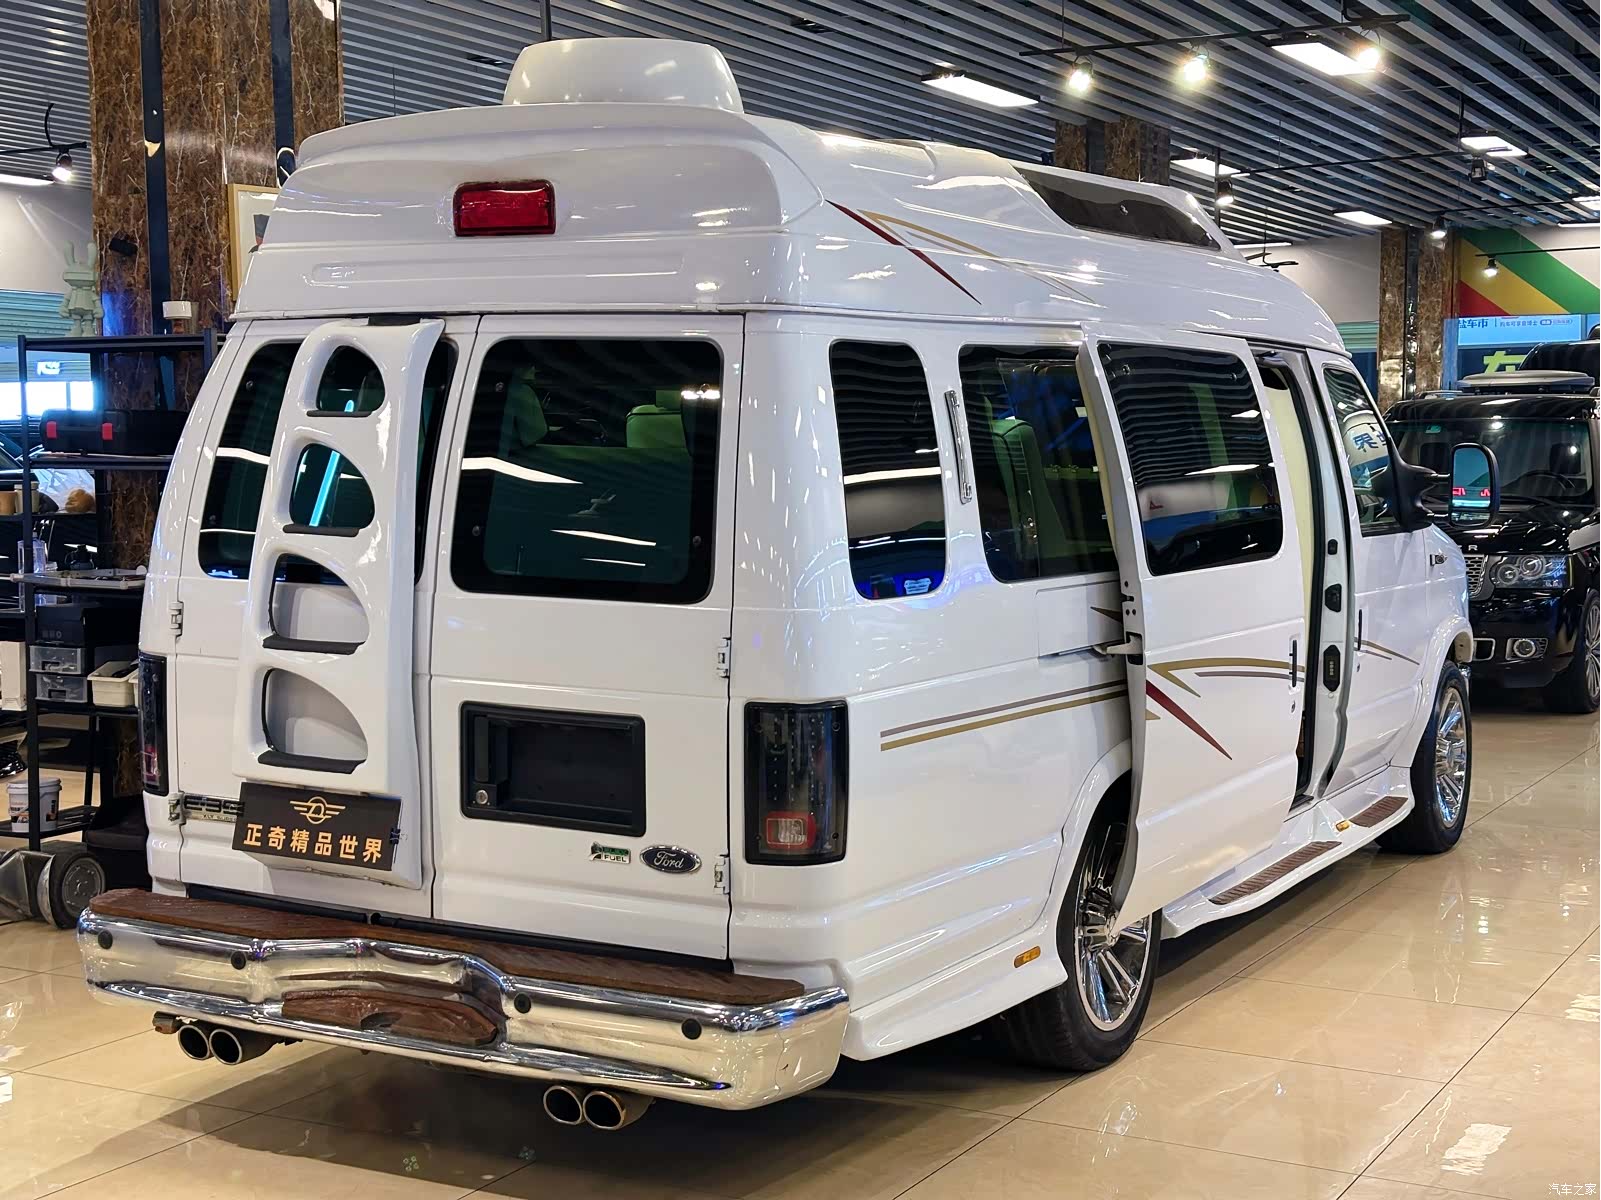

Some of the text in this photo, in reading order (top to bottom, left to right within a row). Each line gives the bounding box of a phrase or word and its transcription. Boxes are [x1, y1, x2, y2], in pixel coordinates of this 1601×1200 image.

[243, 823, 382, 863] 正奇精品世界
[604, 854, 626, 862] FUEL
[653, 851, 684, 869] Ford
